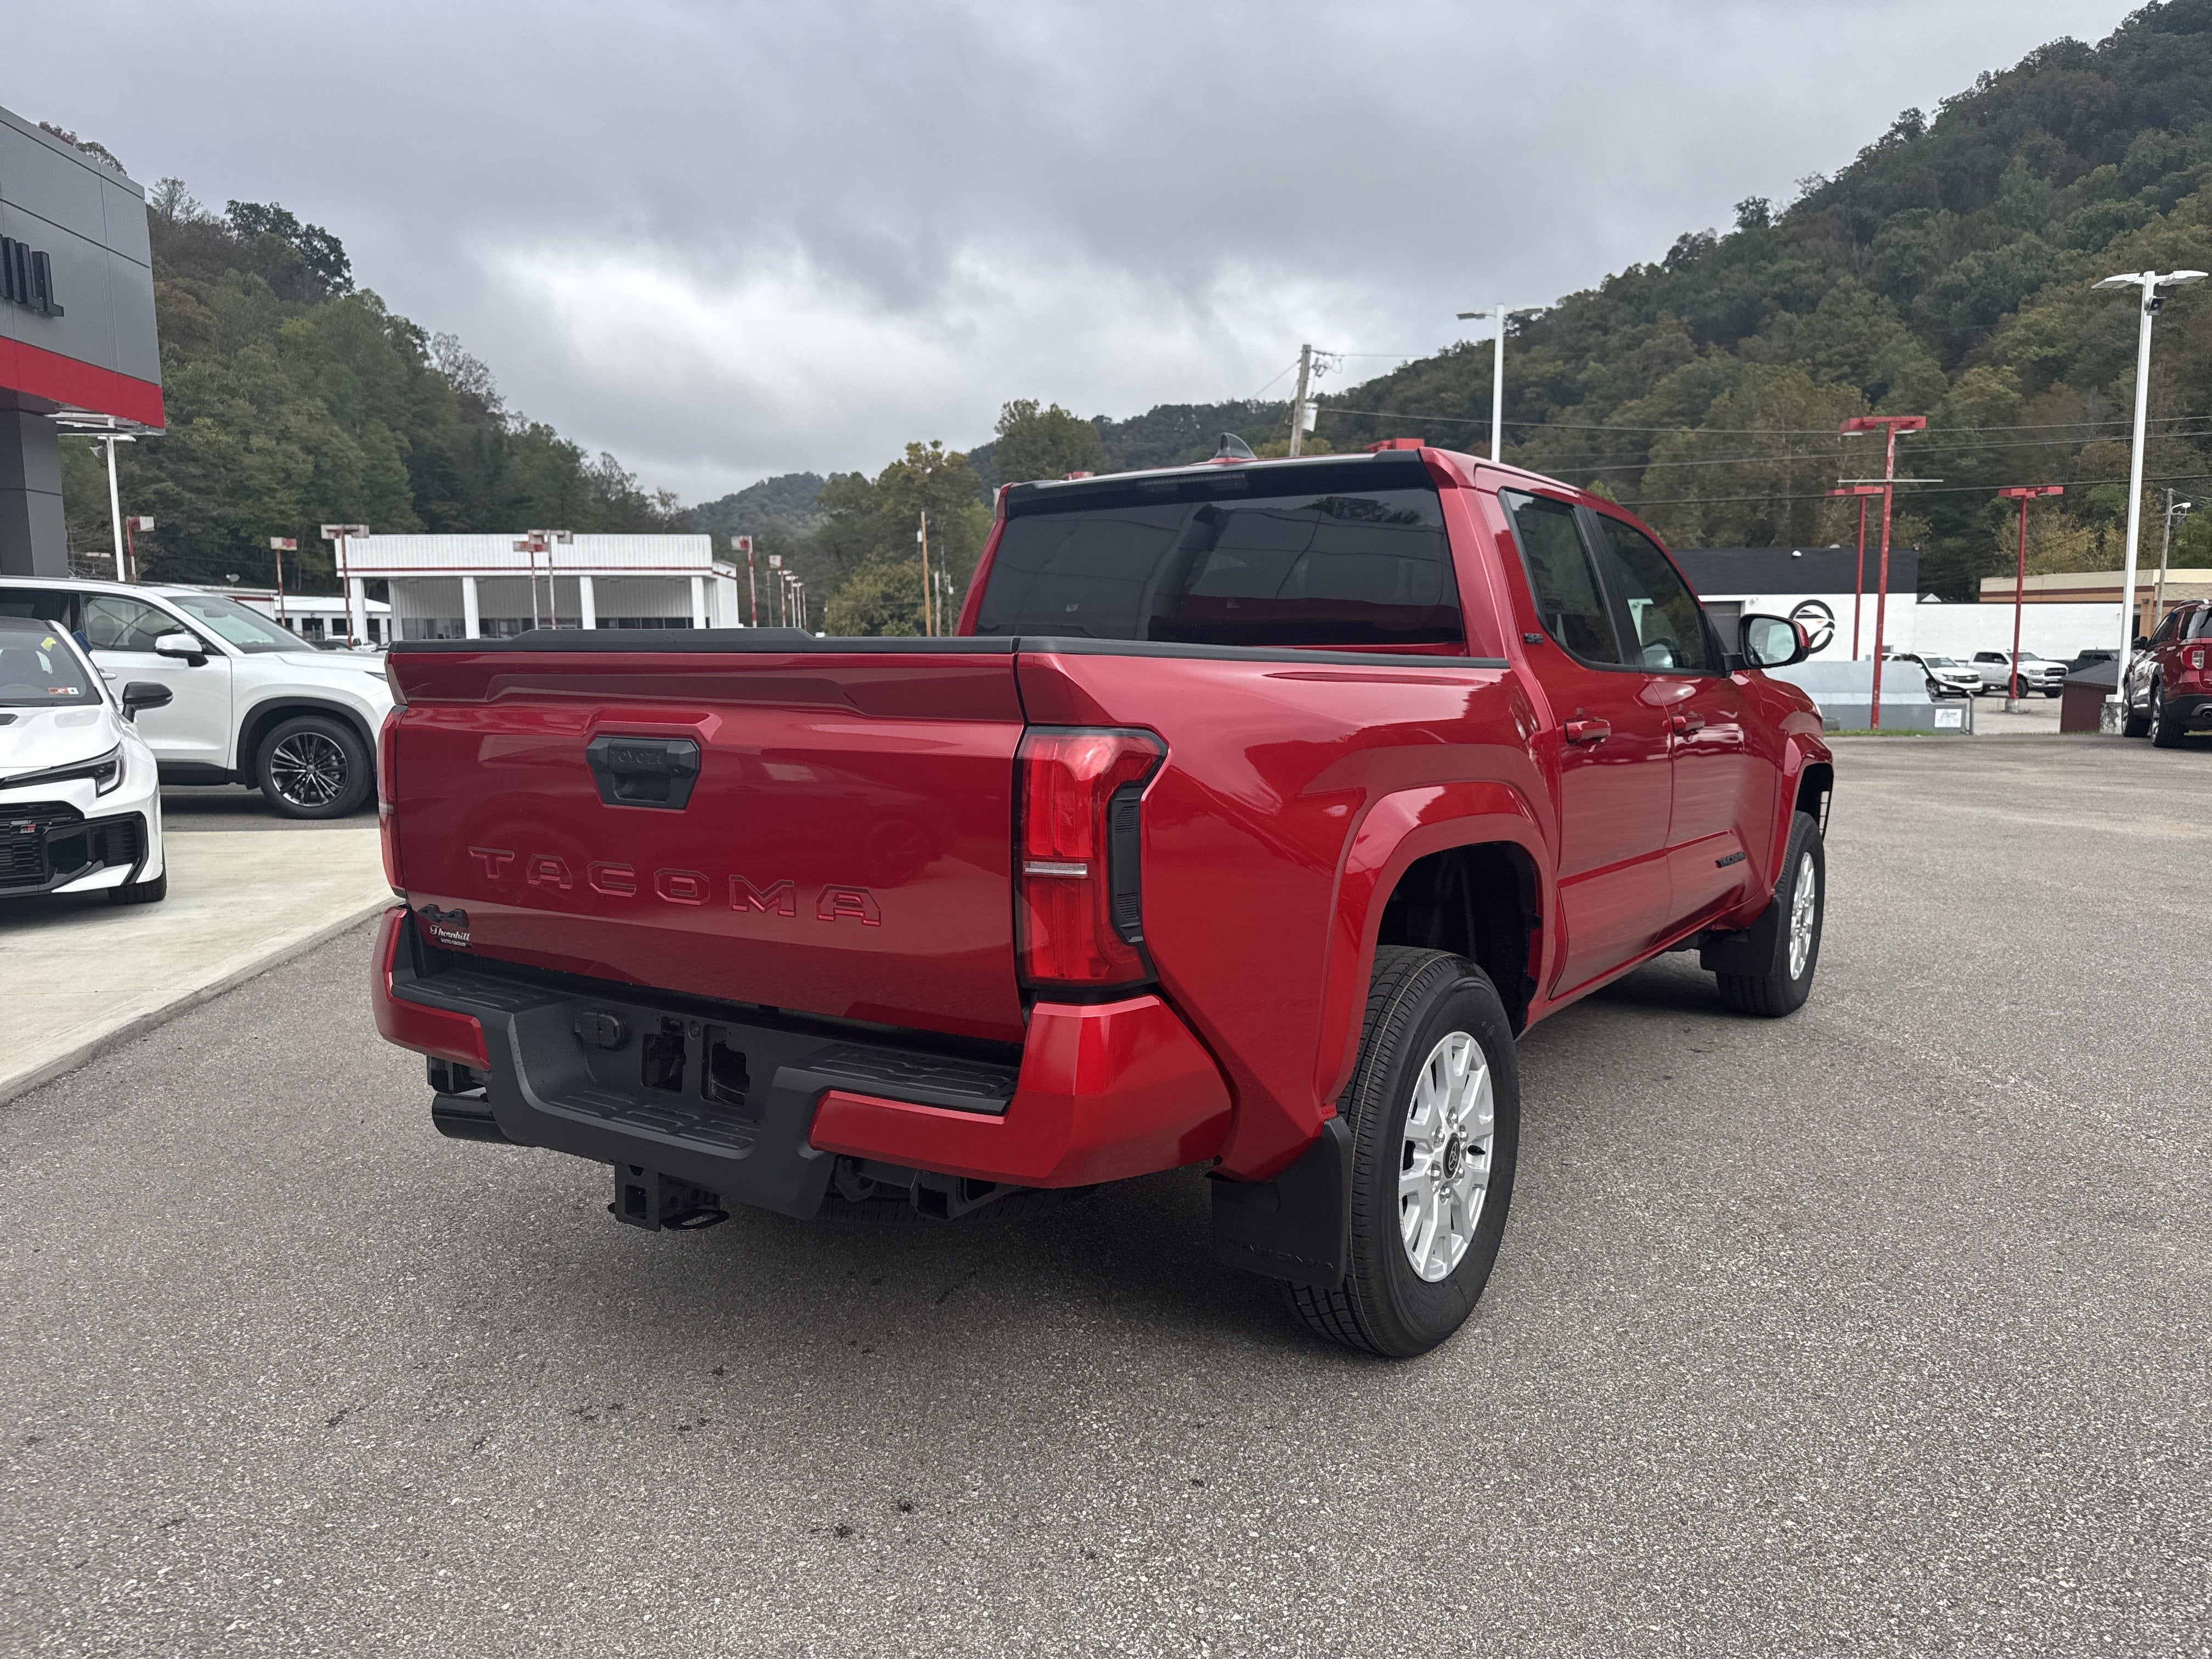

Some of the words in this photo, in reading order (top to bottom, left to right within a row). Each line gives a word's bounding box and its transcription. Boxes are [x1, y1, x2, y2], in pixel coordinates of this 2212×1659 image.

[611, 749, 662, 765] TOYOTA
[468, 847, 881, 926] TACOMA
[430, 924, 470, 941] Thornhill
